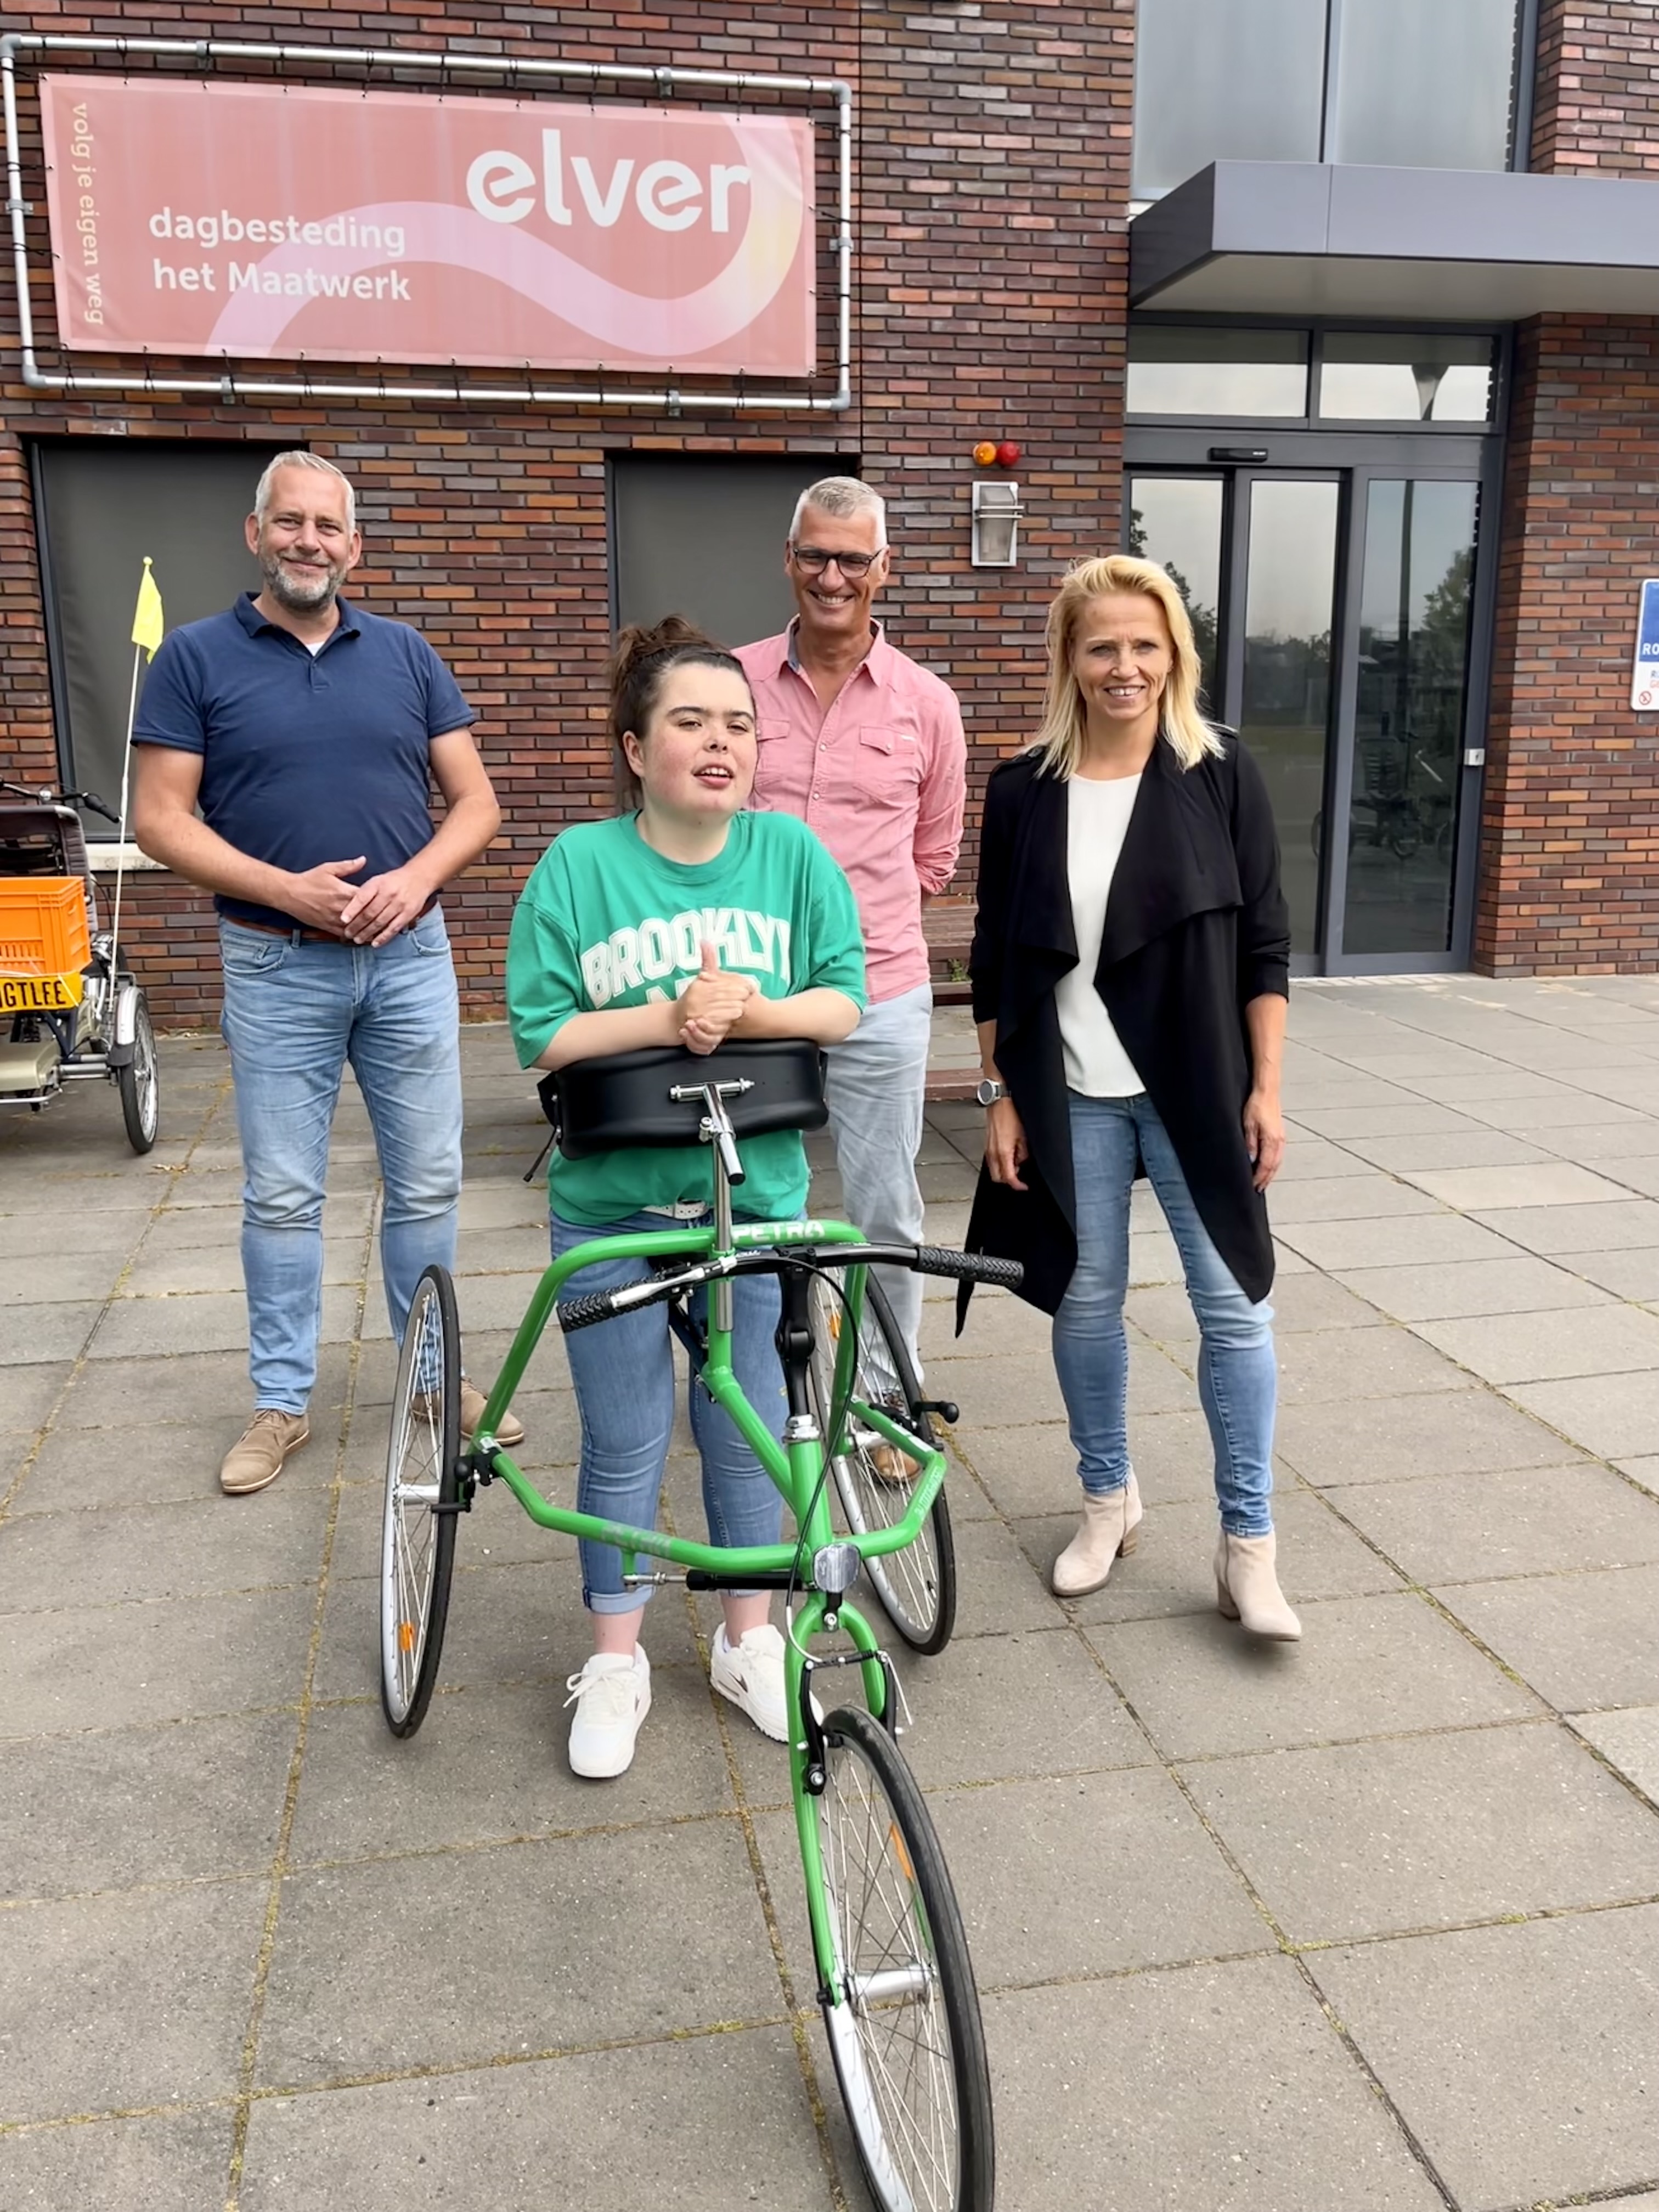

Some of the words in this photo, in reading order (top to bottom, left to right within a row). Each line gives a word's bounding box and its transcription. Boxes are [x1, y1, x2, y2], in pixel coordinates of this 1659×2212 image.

[71, 103, 94, 159] volg
[72, 164, 96, 188] je
[466, 128, 752, 233] elver
[77, 194, 100, 266] eigen
[149, 206, 405, 257] dagbesteding
[84, 273, 104, 325] weg
[153, 258, 216, 291] het
[228, 261, 411, 301] Maatwerk
[731, 1220, 825, 1244] PETRA
